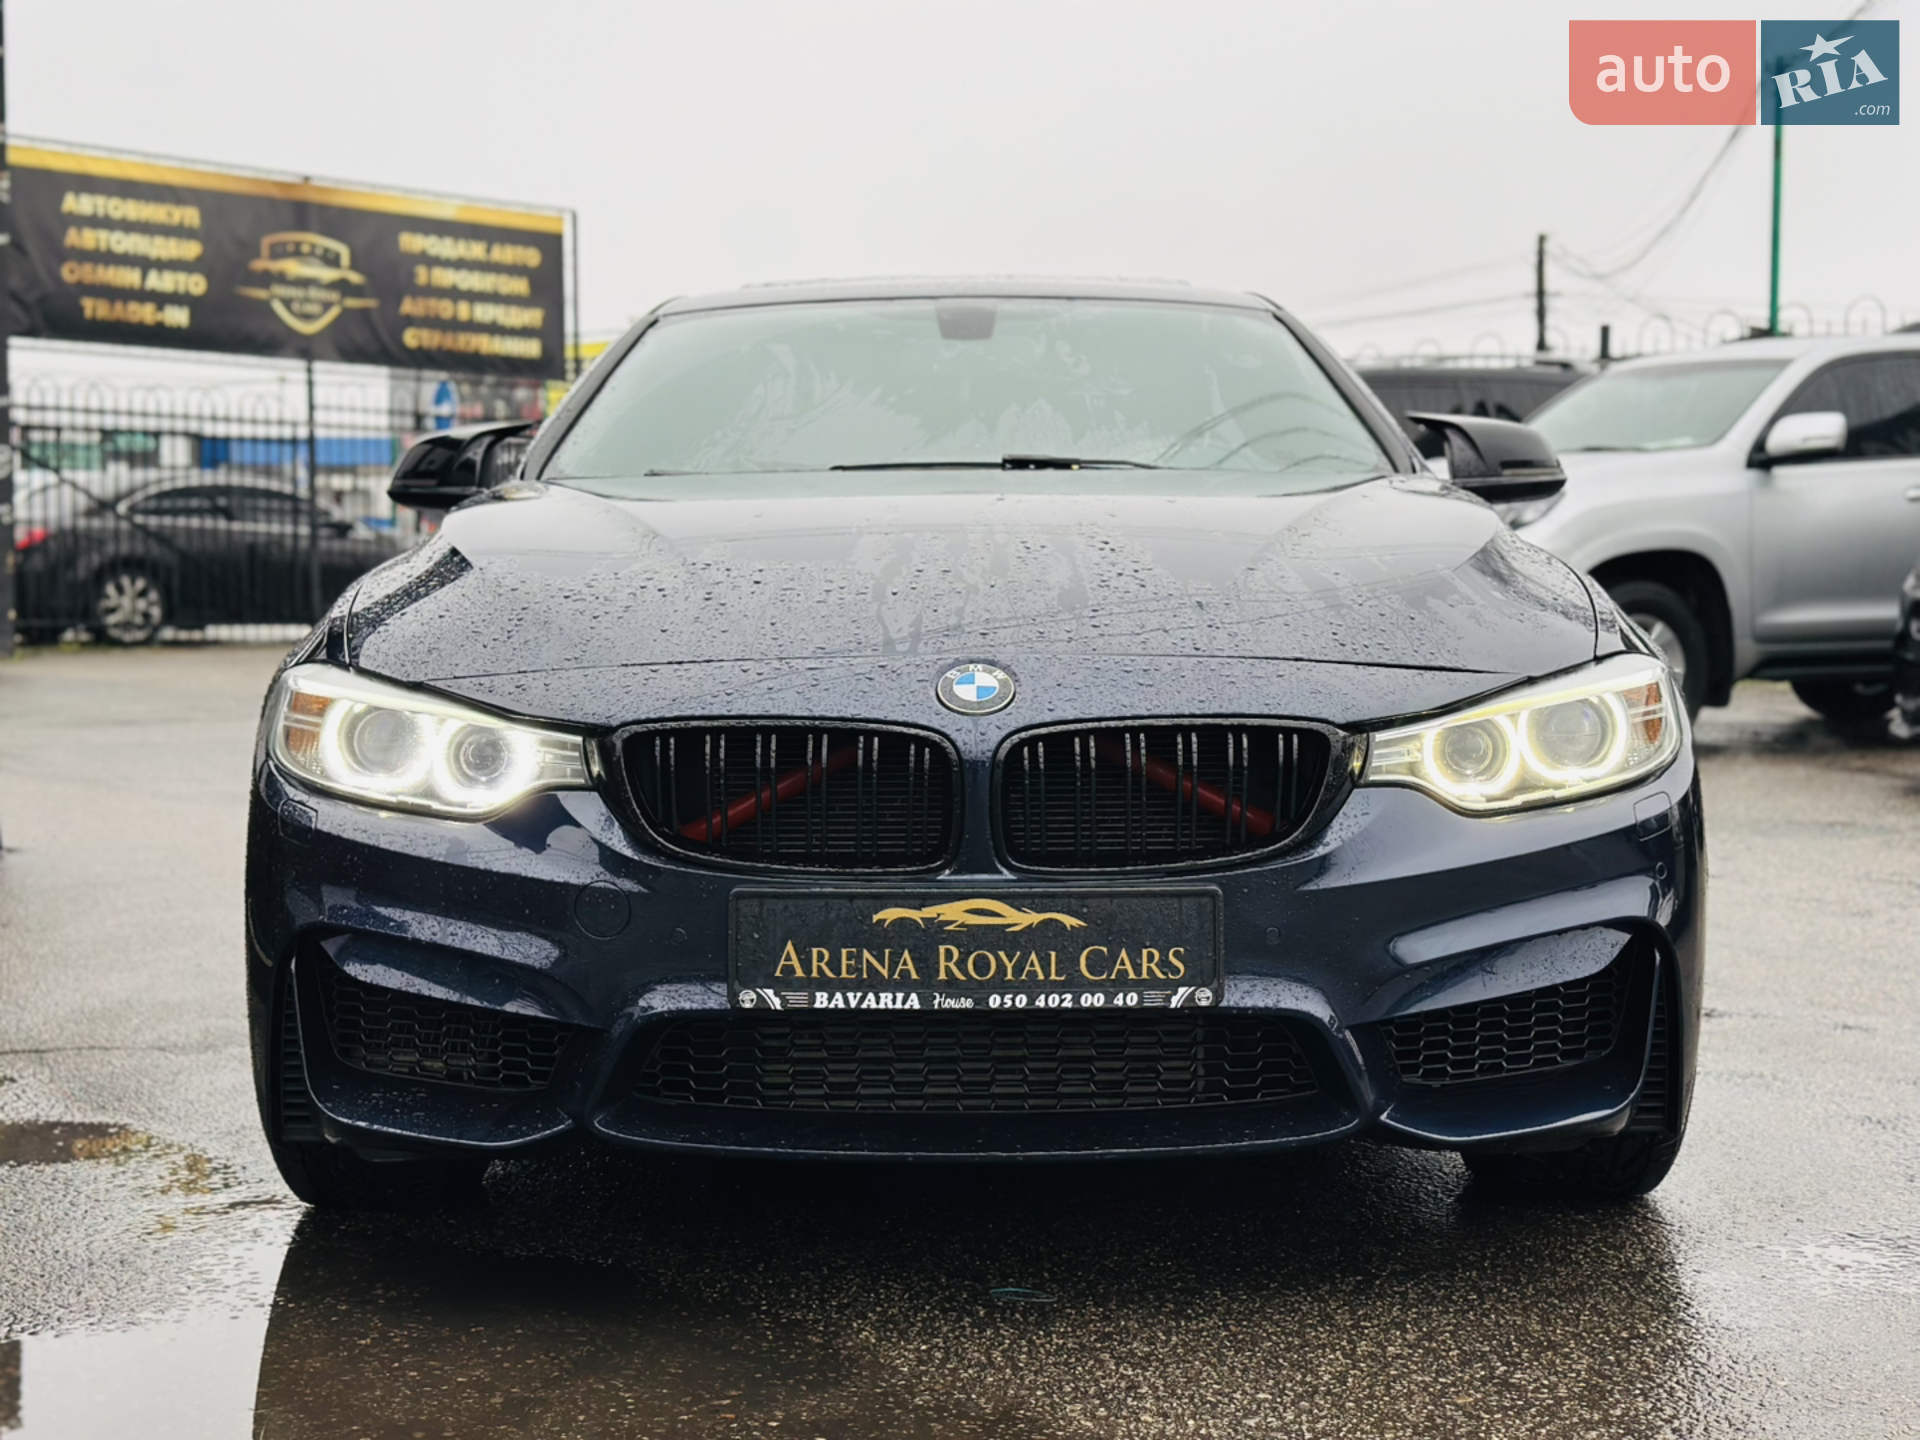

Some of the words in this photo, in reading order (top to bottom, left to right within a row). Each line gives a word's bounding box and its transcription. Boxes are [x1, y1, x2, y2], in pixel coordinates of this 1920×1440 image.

[144, 267, 208, 297] АВТО
[79, 296, 191, 329] TRADE-IN
[945, 664, 1008, 679] BMW
[813, 991, 921, 1009] BAVARIA
[933, 992, 974, 1010] House
[988, 993, 1028, 1009] 050
[1035, 993, 1073, 1009] 402
[1080, 992, 1105, 1008] 00
[1113, 991, 1138, 1007] 40
